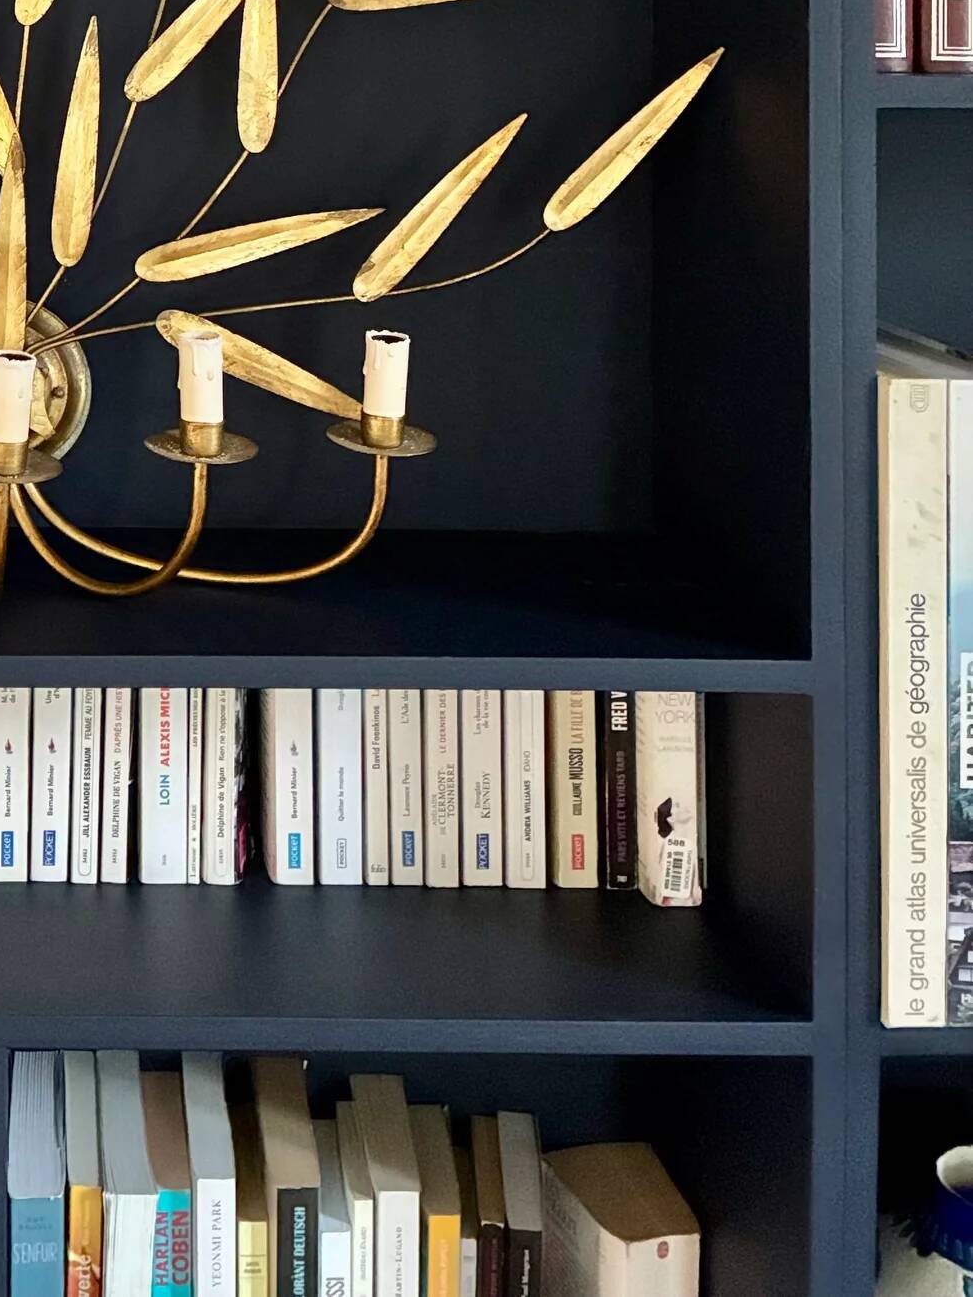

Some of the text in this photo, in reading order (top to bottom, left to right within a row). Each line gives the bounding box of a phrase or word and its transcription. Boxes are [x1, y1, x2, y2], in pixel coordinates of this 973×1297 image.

[610, 702, 627, 731] FRED
[655, 710, 696, 724] YORK
[658, 693, 692, 707] NEW
[84, 716, 93, 740] FEMME
[372, 705, 381, 770] David Foenkinos
[439, 693, 447, 753] LE DERNIER DES
[570, 711, 584, 732] FILLE
[570, 733, 584, 744] LA
[47, 764, 55, 788] Minier
[83, 747, 92, 780] ESSBAUM
[113, 760, 121, 785] VIGAN
[159, 720, 170, 806] LOIN ALEXIS
[217, 768, 227, 790] Vigan
[568, 747, 584, 781] MUSSO
[4, 766, 12, 818] Bernard Minier
[83, 782, 91, 823] ALEXANDER
[112, 785, 121, 798] DE
[217, 791, 225, 802] de
[437, 767, 446, 825] CLERMONT-
[446, 763, 456, 818] TONNERRE
[481, 771, 491, 819] KENNEDY
[904, 593, 930, 1016] le grand atlas universalis de géographie
[82, 824, 90, 838] JILL
[111, 798, 120, 838] DELPHINE
[217, 803, 226, 838] Delphine
[524, 815, 532, 842] ANDRIA
[3, 833, 12, 865] POCKET
[43, 831, 55, 865] POCKET
[290, 835, 299, 867] POCKET
[403, 832, 414, 866] POCKET
[477, 834, 489, 869] POCKET
[573, 835, 583, 869] POCKET
[171, 1211, 190, 1286] COBEN
[211, 1199, 222, 1288] YEONMI PARK
[293, 1206, 306, 1257] DEUTSCH
[155, 1212, 169, 1287] HARLAN
